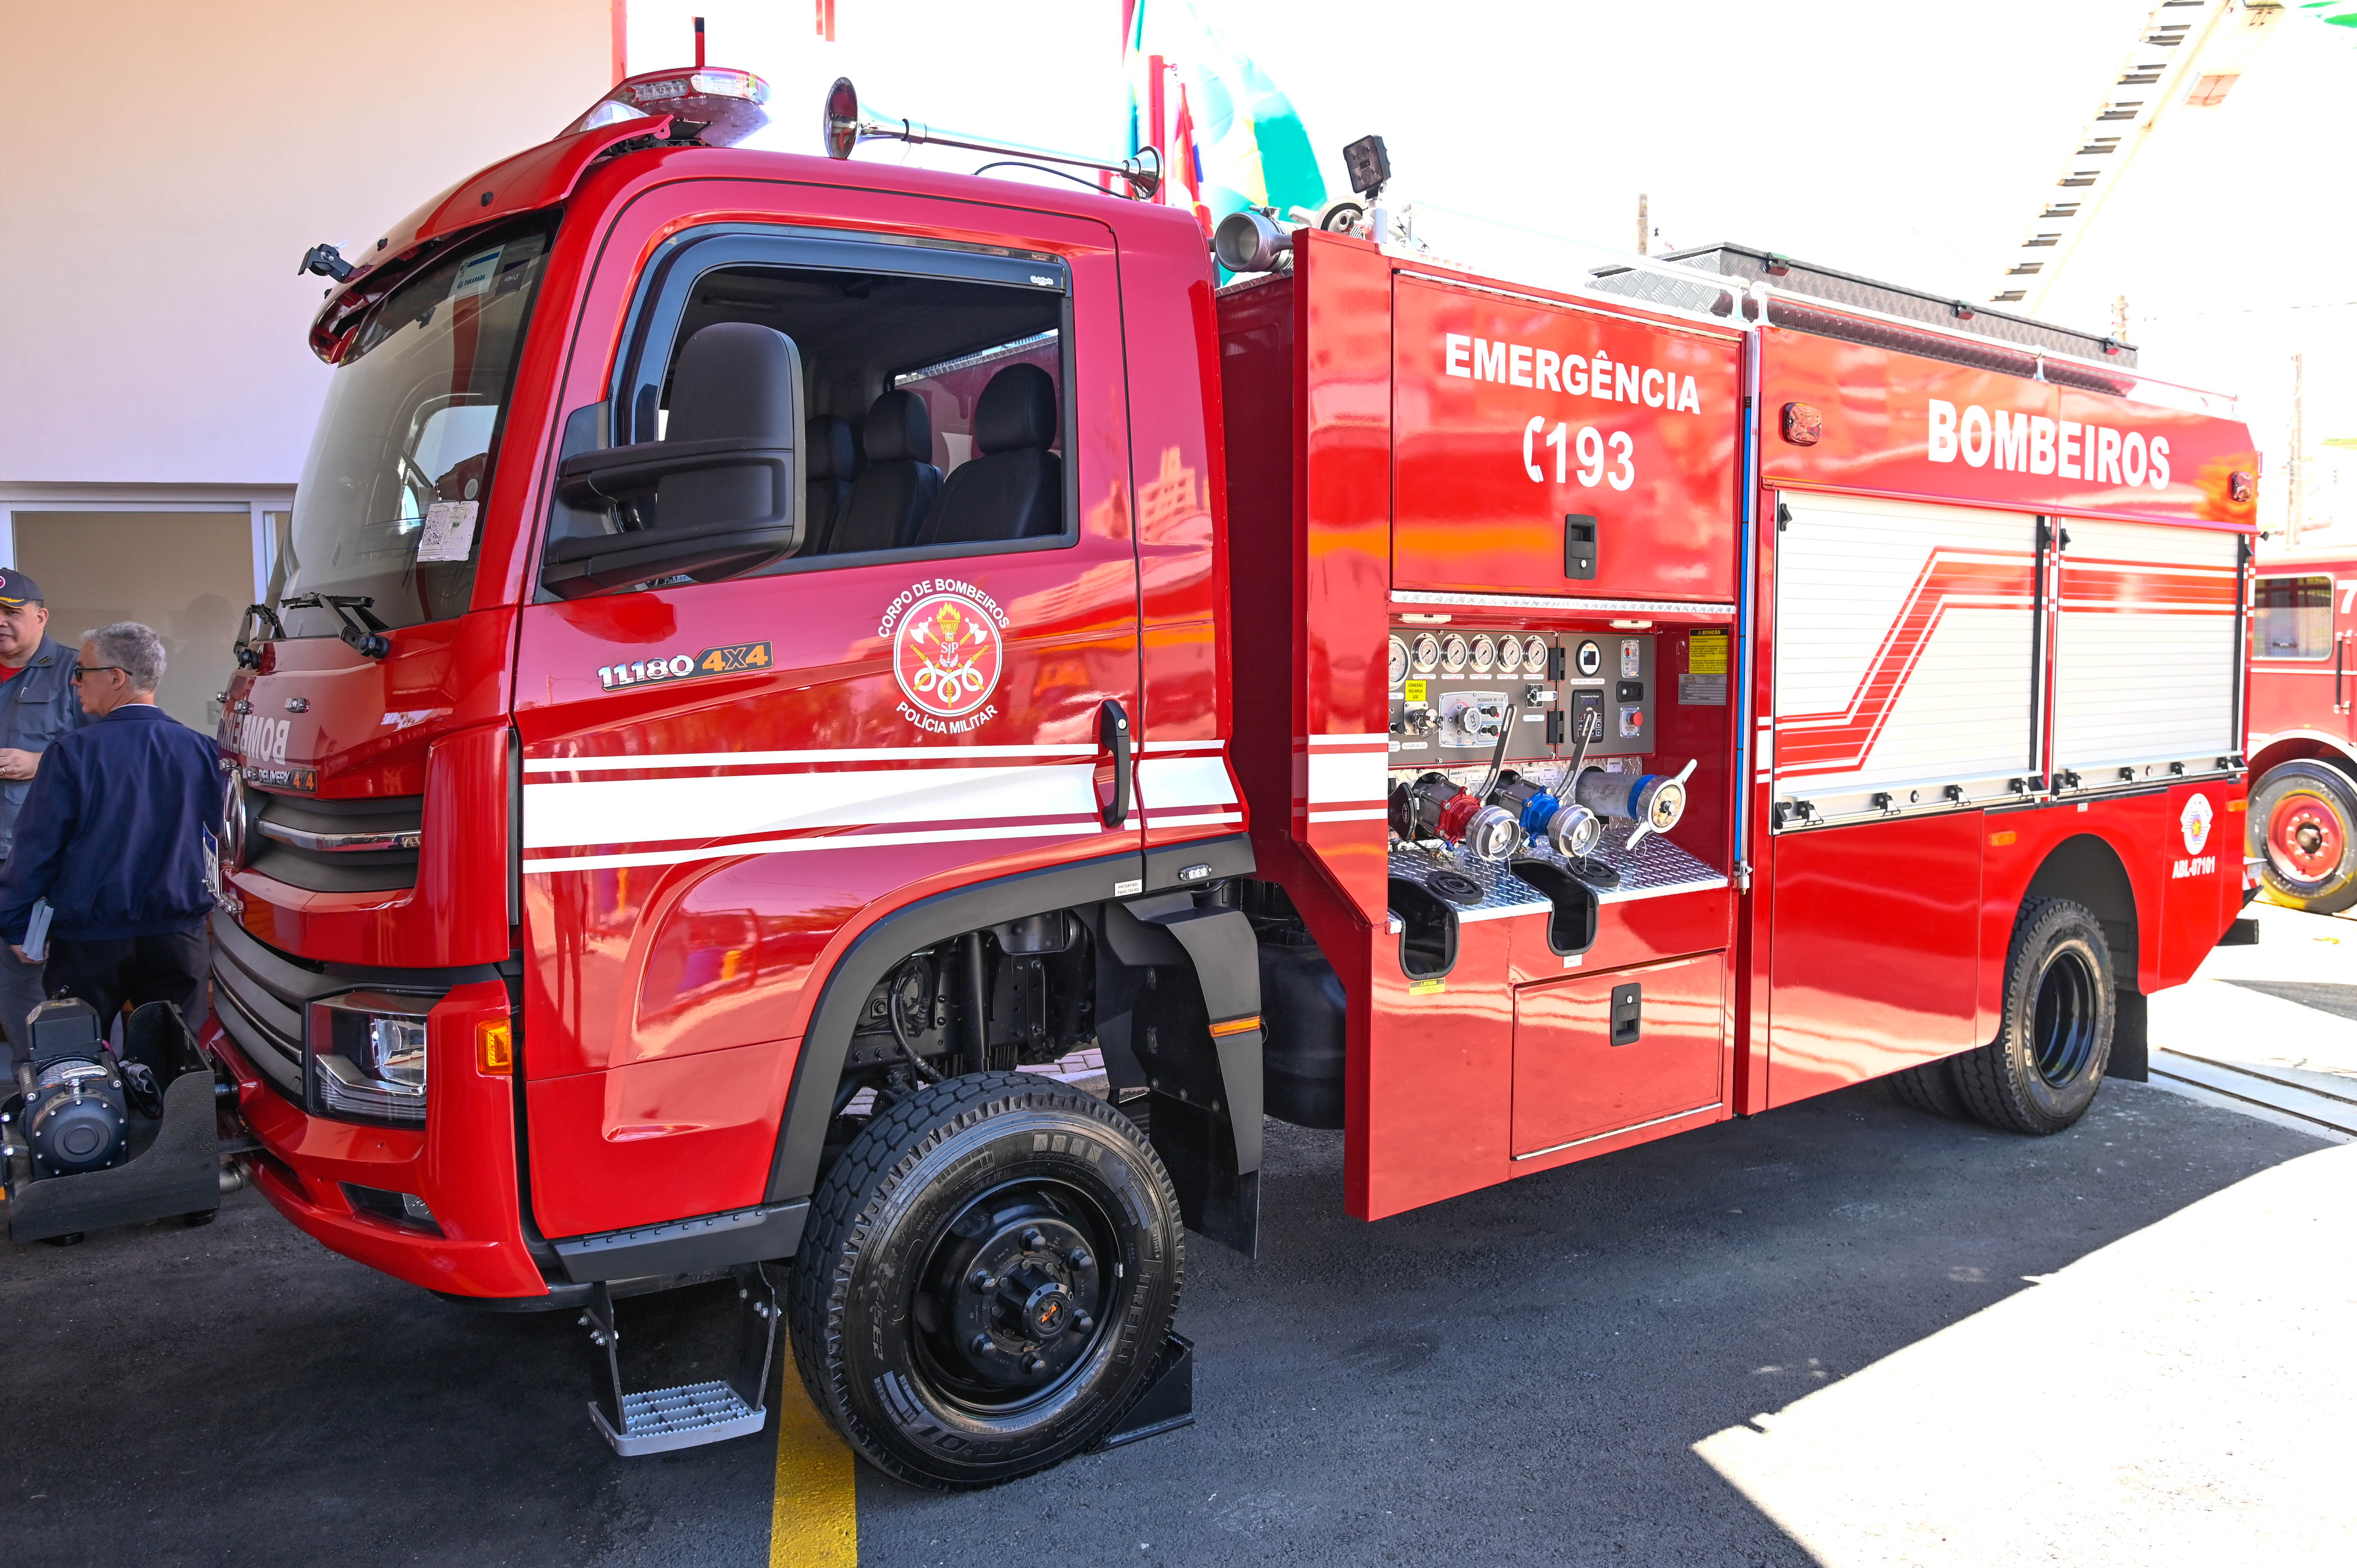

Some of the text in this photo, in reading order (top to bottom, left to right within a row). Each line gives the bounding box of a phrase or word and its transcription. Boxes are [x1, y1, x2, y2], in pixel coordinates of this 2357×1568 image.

[1446, 333, 1700, 415] EMERGÊNCIA
[1546, 422, 1634, 491] 193
[1928, 399, 2170, 490] BOMBEIROS
[878, 579, 1009, 638] CORPO DE BOMBEIROS
[2337, 580, 2357, 614] 7
[702, 645, 768, 671] 4X4
[896, 701, 998, 734] POLÍCIA MILITAR
[258, 769, 315, 790] DELIVERY 4X4
[2172, 856, 2216, 879] ABL-07101
[1041, 1305, 1057, 1323] 4X4
[1115, 1259, 1162, 1366] PIRELLI
